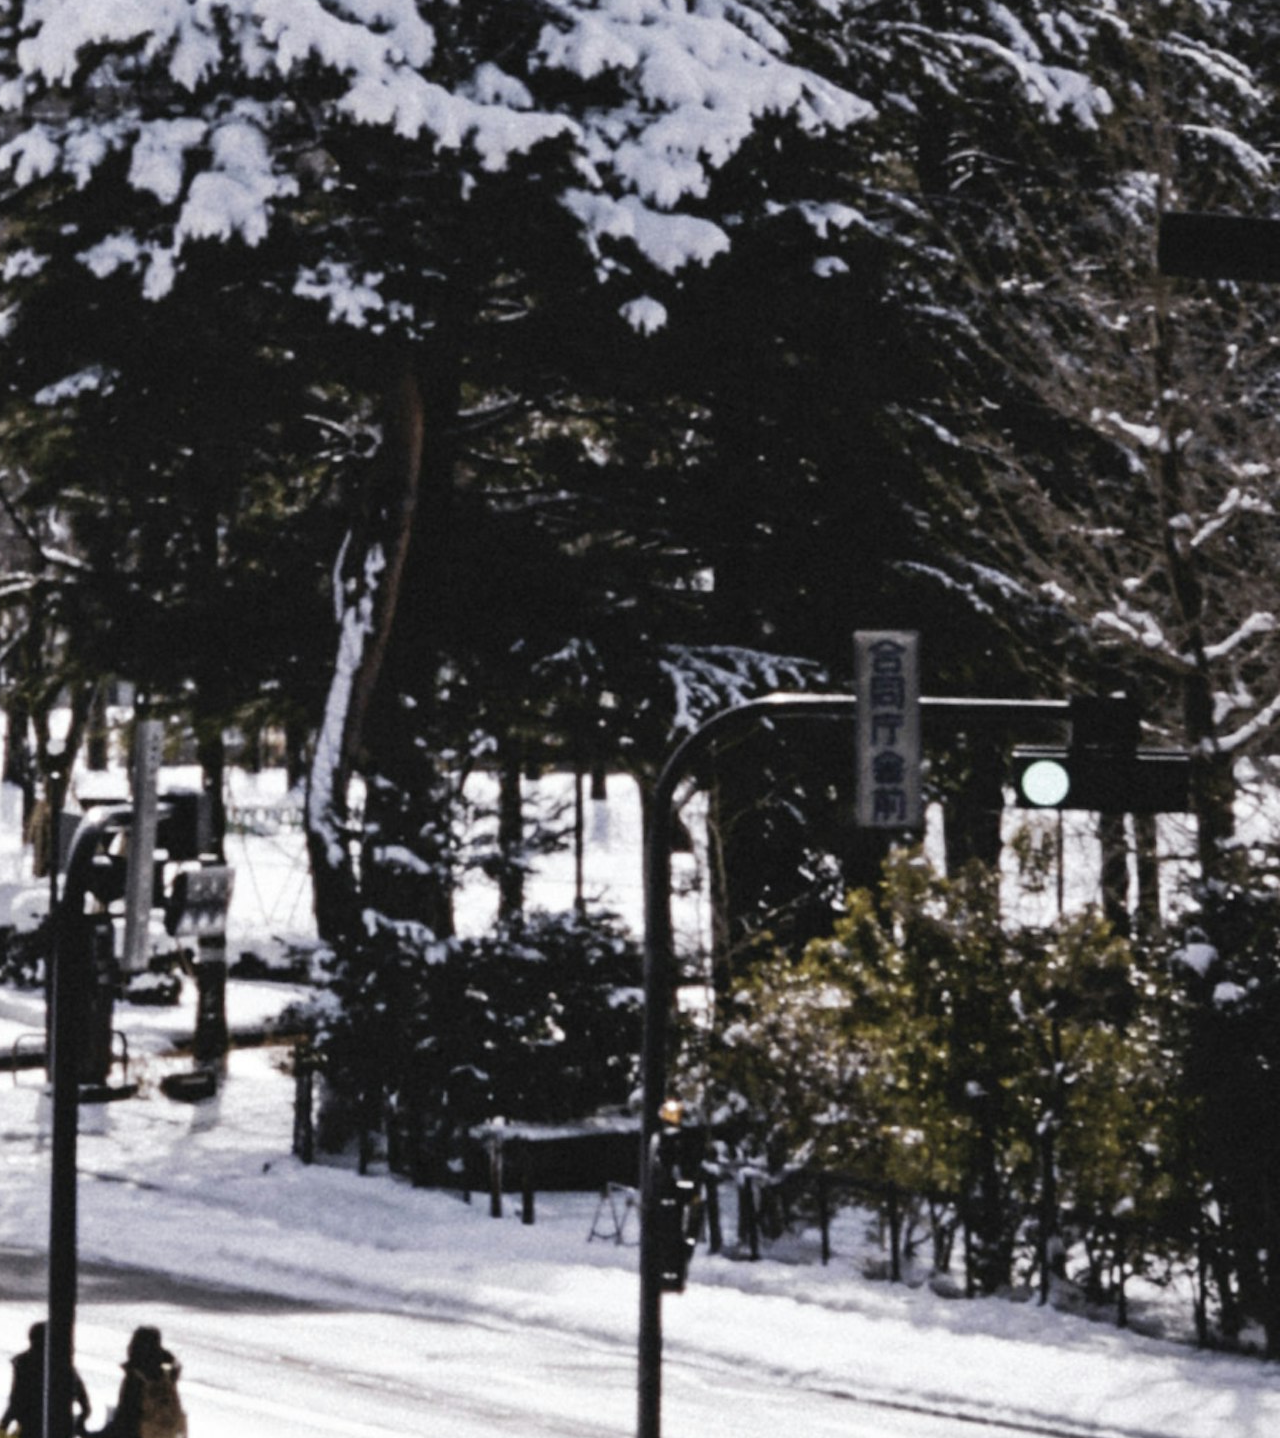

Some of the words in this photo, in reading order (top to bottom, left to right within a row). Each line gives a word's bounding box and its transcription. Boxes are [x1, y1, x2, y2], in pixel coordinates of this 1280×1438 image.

[868, 639, 907, 822] 合同庁舎前
